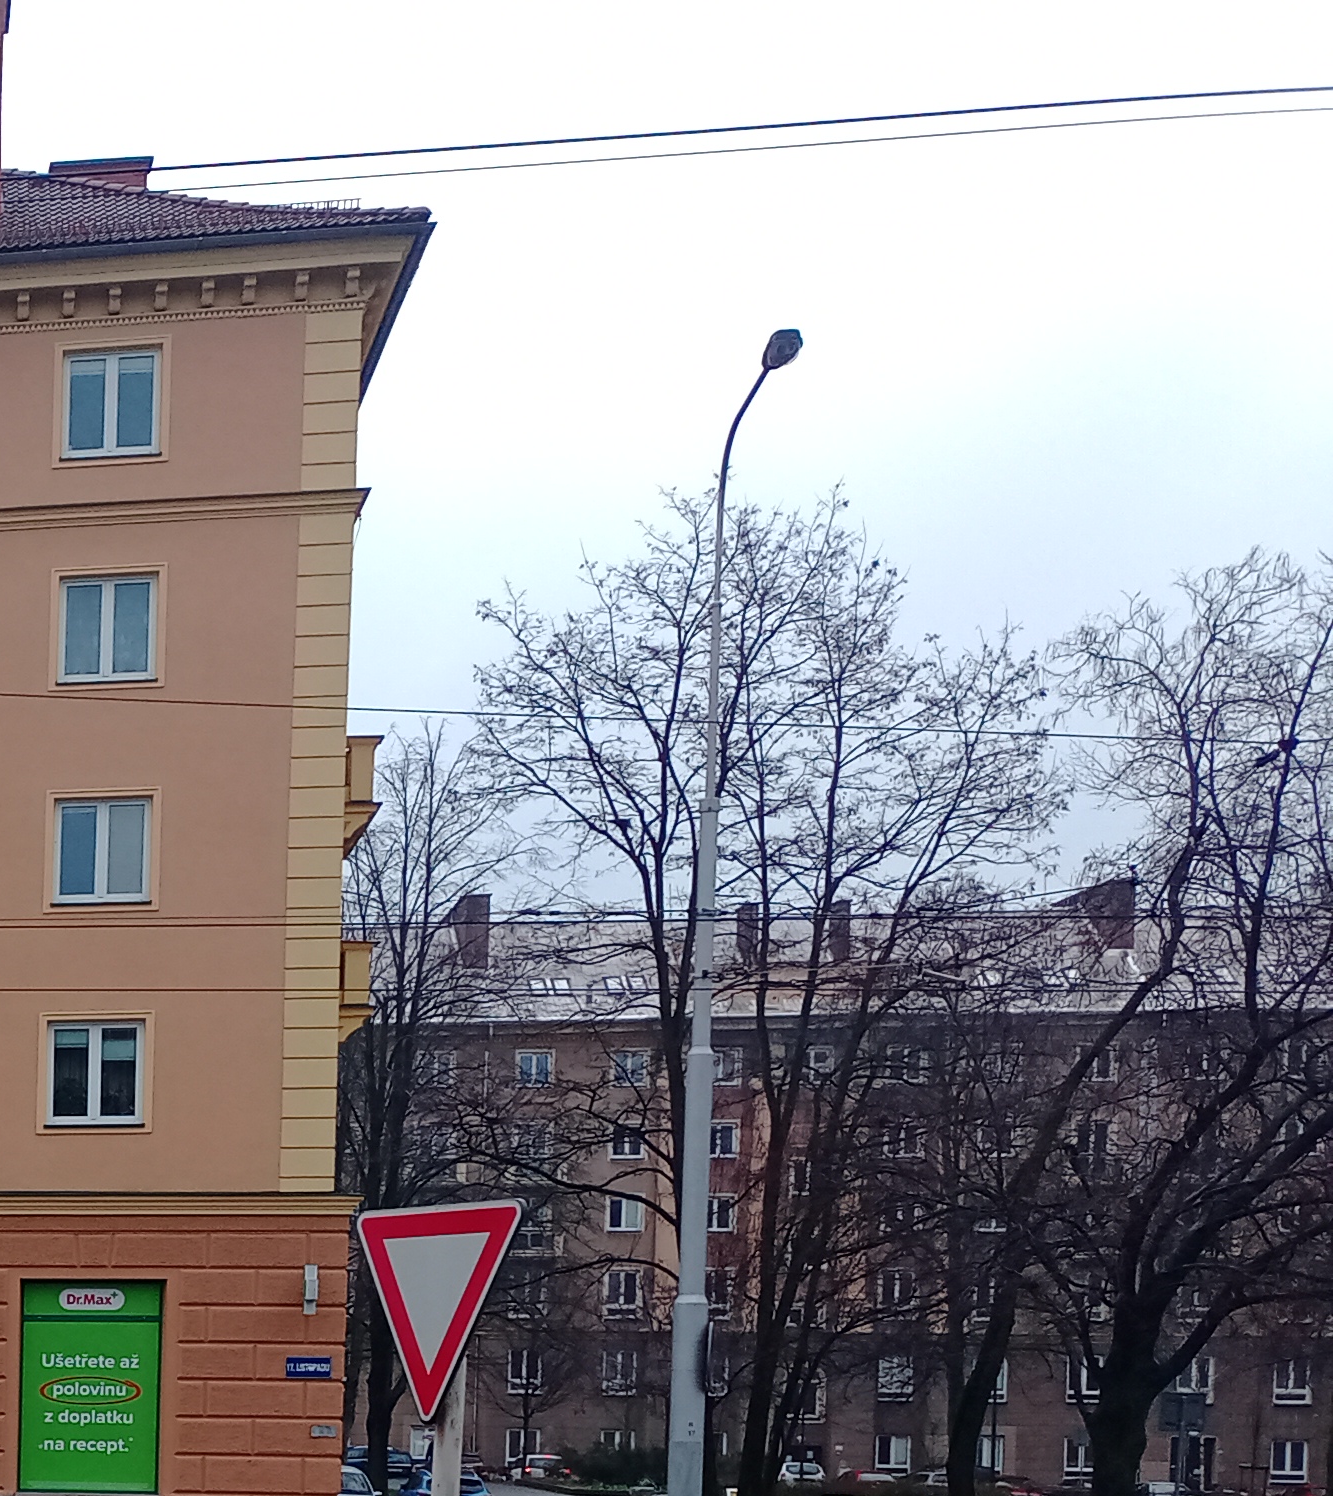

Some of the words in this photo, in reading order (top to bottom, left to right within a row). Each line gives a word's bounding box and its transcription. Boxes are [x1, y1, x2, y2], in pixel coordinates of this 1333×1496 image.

[41, 1353, 115, 1369] Ušetřete
[119, 1354, 139, 1369] až
[52, 1381, 127, 1398] polovinu
[44, 1411, 53, 1423] z
[57, 1409, 133, 1426] doplatku
[43, 1438, 65, 1451] na
